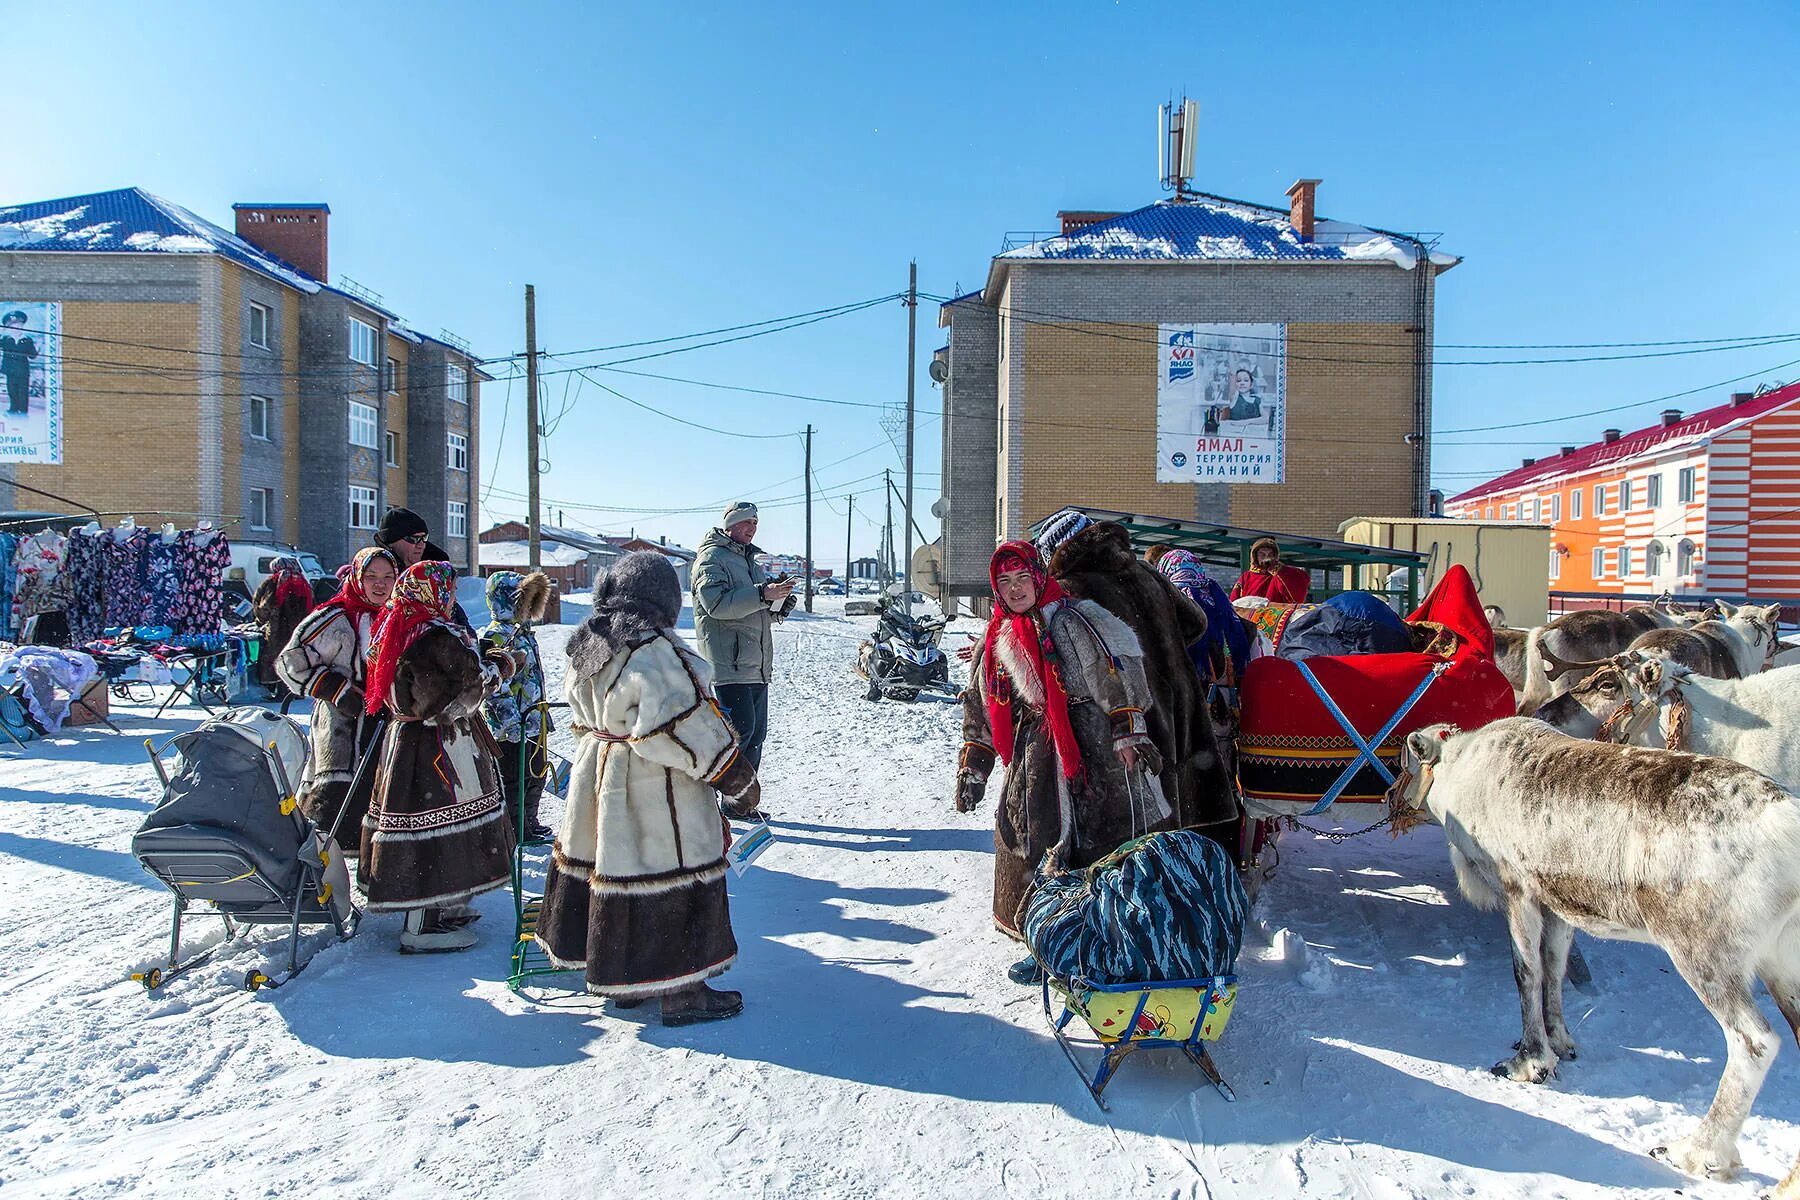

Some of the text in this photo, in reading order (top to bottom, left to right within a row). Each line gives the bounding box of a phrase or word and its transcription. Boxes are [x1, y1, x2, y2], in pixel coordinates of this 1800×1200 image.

[1170, 360, 1194, 368] ЯНАО
[1196, 439, 1243, 452] ЯМАЛ
[1196, 454, 1271, 463] ТЕРРИТОРИЯ
[1196, 464, 1260, 475] ЗНАНИЙ
